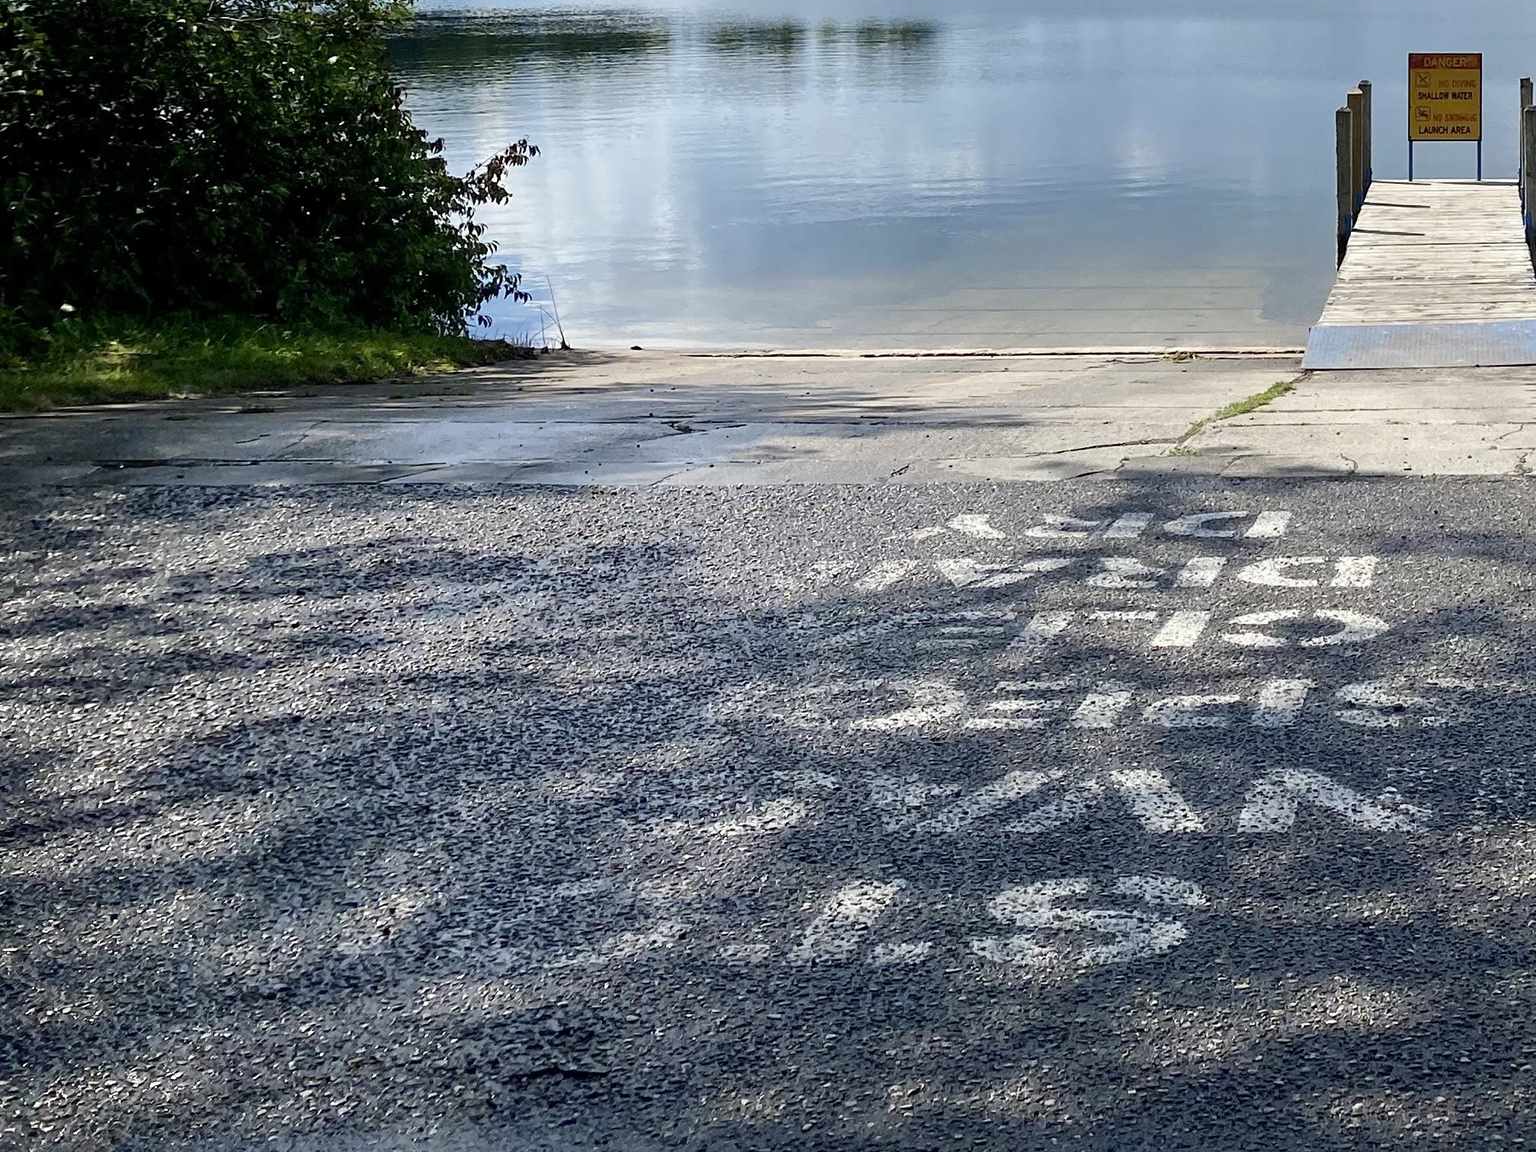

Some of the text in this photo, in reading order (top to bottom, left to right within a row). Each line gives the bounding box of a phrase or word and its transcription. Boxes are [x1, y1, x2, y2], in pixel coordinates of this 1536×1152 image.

[1423, 56, 1466, 67] DANGER
[1417, 91, 1473, 100] SHALLOW WATER
[1418, 126, 1472, 135] LAUNCH AREA
